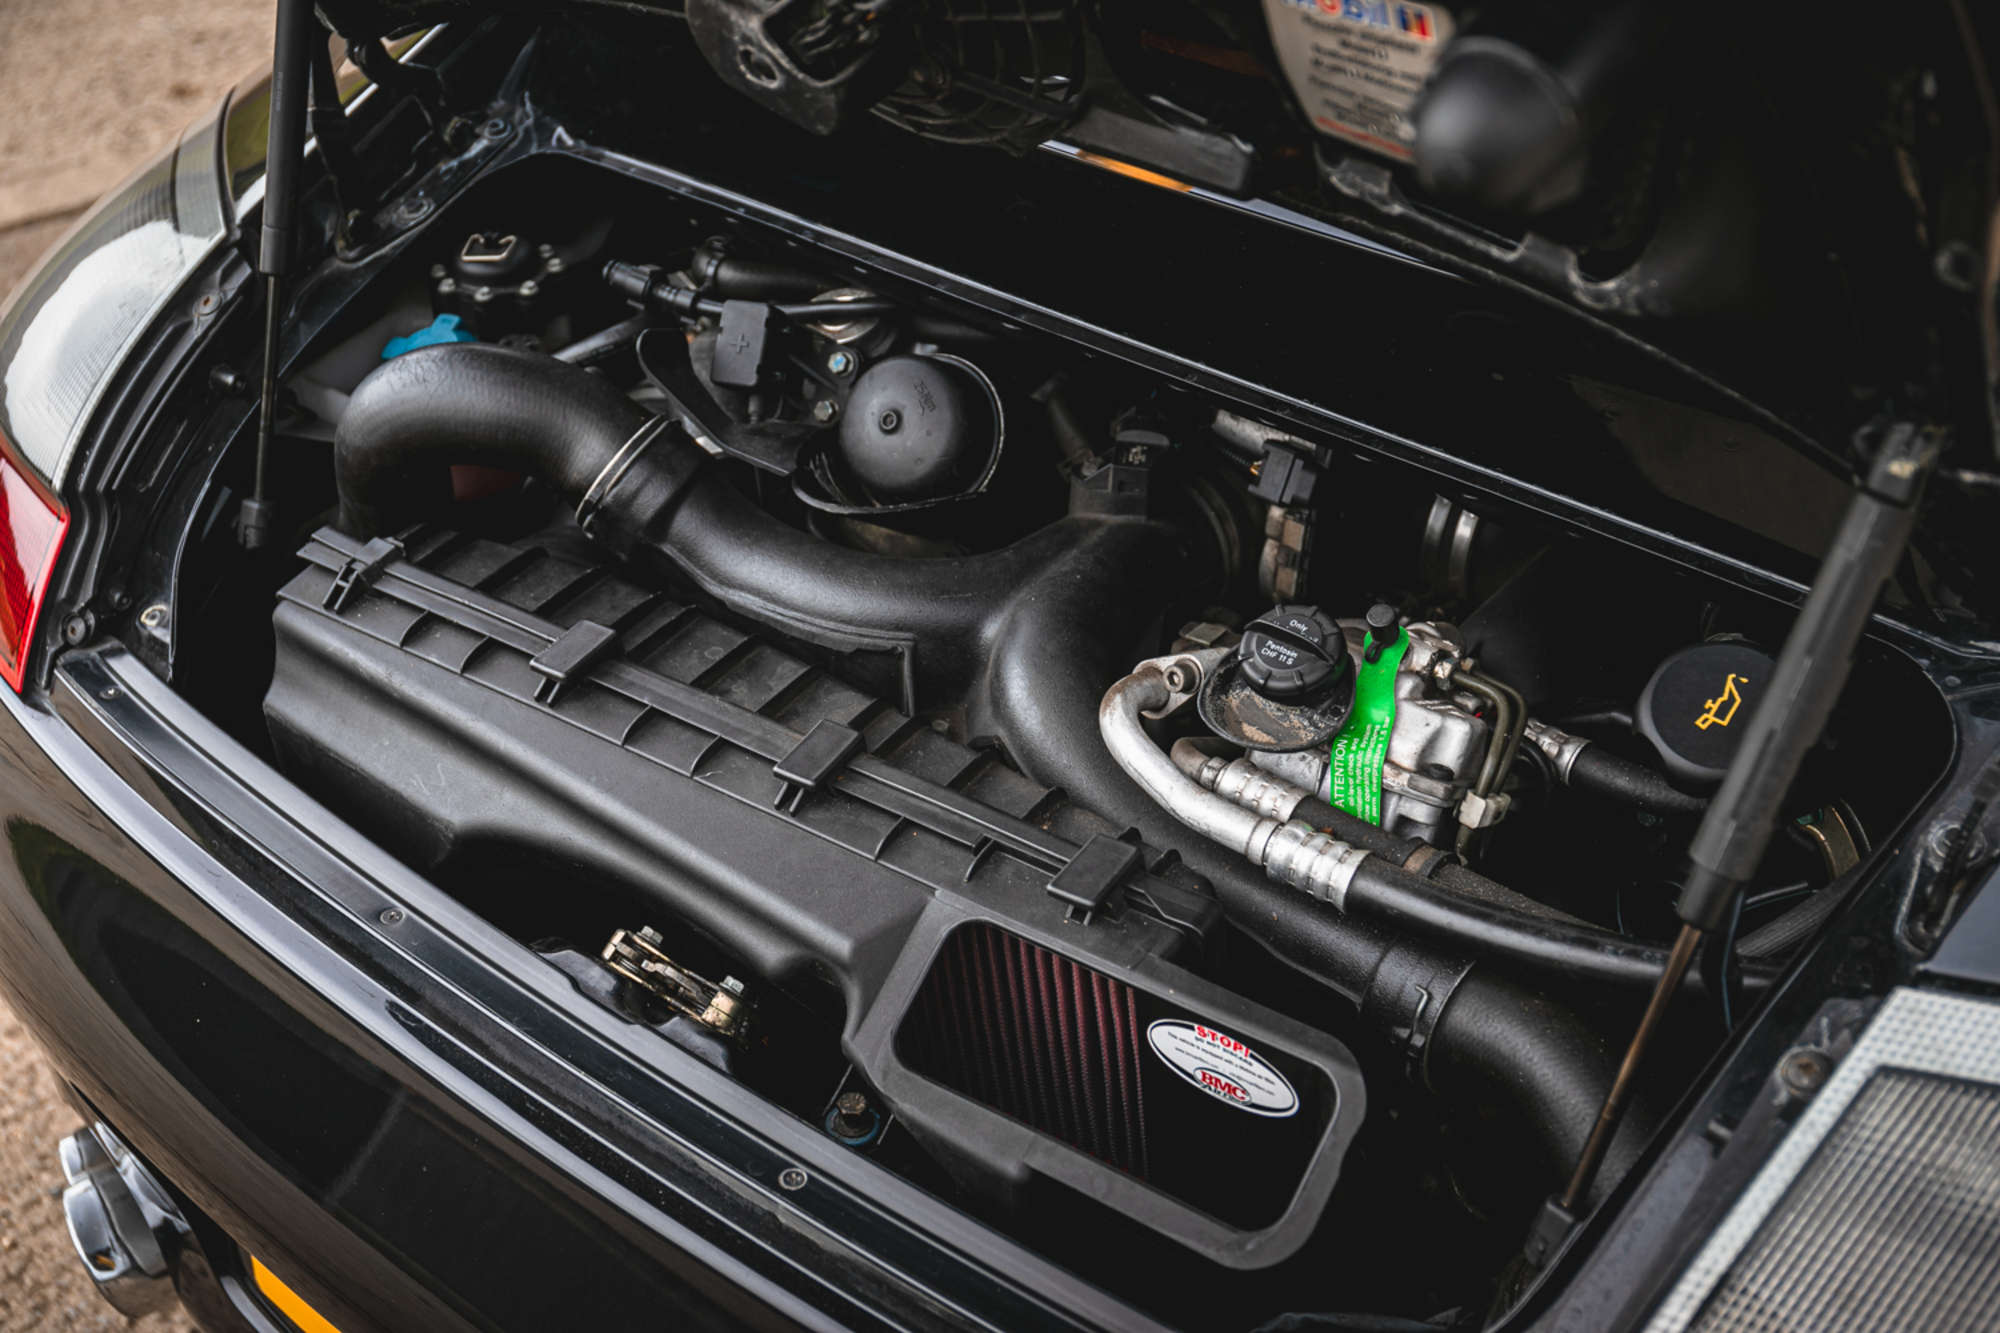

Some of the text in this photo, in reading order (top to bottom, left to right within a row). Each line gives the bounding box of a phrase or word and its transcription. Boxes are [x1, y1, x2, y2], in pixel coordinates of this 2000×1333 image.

[1289, 619, 1309, 632] Only
[1261, 647, 1277, 658] CHF
[1286, 657, 1294, 665] S
[1265, 640, 1298, 659] Pentosin
[1350, 738, 1359, 751] and
[1356, 751, 1364, 784] hydraulic
[1360, 724, 1372, 748] system
[1364, 725, 1380, 765] instructions
[1334, 739, 1348, 808] ATTENTION
[1363, 768, 1371, 801] operating
[1371, 744, 1383, 792] overpressure
[1196, 1025, 1251, 1058] STOP!
[1200, 1070, 1247, 1101] BMC
